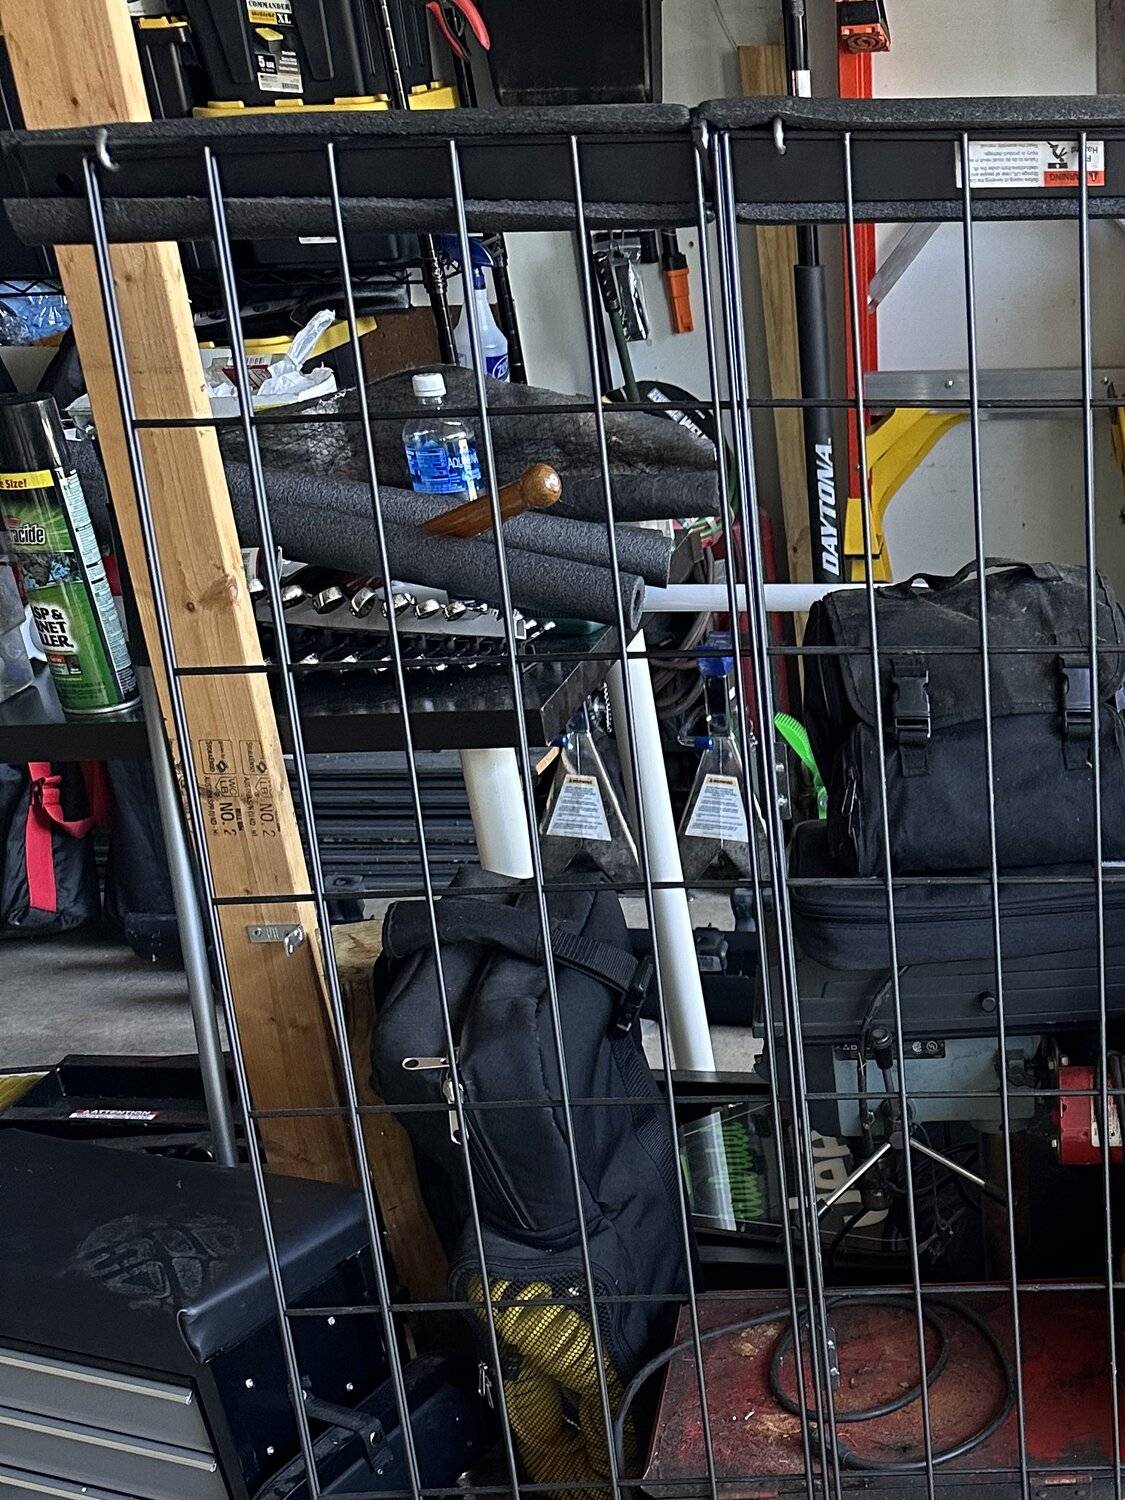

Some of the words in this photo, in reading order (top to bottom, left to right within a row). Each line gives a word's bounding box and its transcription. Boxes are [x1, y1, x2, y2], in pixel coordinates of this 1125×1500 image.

[277, 13, 292, 24] XL
[6, 479, 27, 489] Size!
[815, 444, 840, 577] DAYTONA
[219, 802, 235, 825] NO.
[260, 803, 275, 826] NO.
[223, 829, 237, 837] 2
[263, 830, 276, 838] 2
